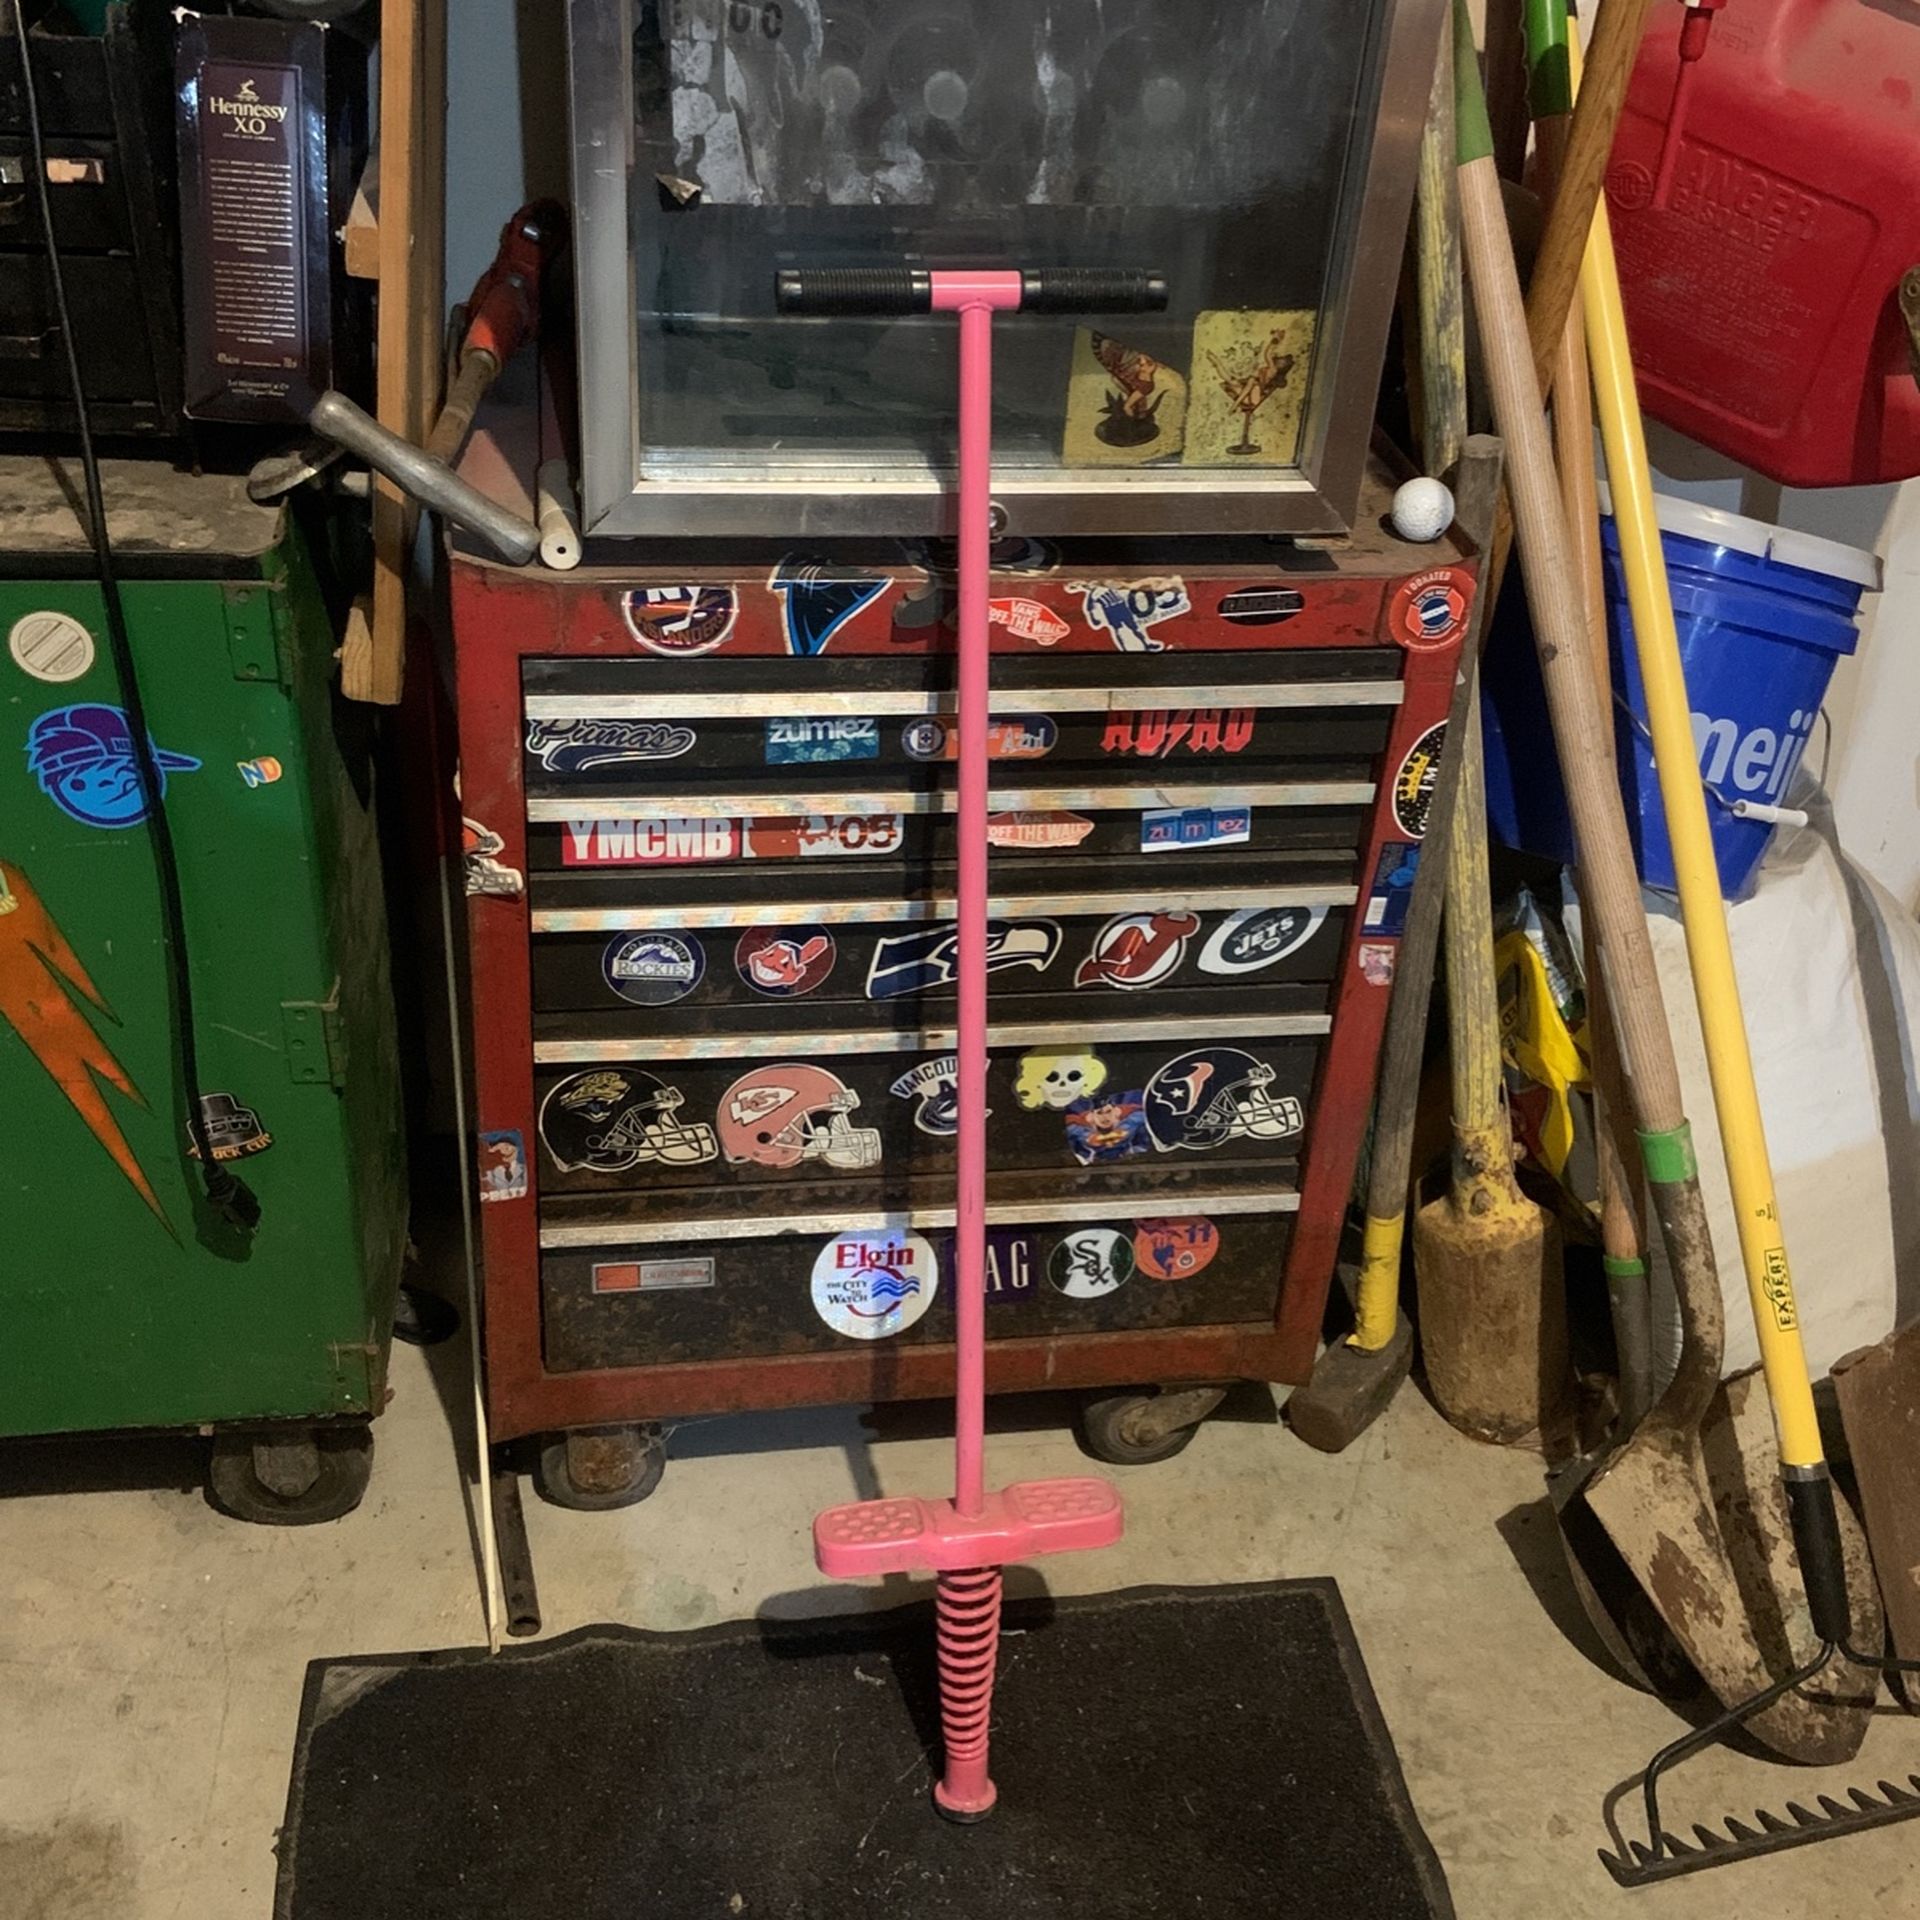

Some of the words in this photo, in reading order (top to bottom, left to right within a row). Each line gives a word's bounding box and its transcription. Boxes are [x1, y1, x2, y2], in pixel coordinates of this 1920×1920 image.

[209, 96, 288, 123] Hennessy
[1408, 571, 1452, 592] DONATED
[640, 611, 725, 645] ISLANDERS
[768, 719, 876, 743] zumiez
[567, 819, 735, 860] YMCMB
[1017, 824, 1047, 843] THE
[1233, 915, 1295, 956] JETS
[622, 936, 689, 961] COLORADO
[615, 961, 692, 977] ROCKIES
[834, 1241, 915, 1269] Elgin
[842, 1280, 868, 1292] CITY
[1768, 1252, 1792, 1327] EXPERT
[828, 1294, 868, 1305] WATCH
